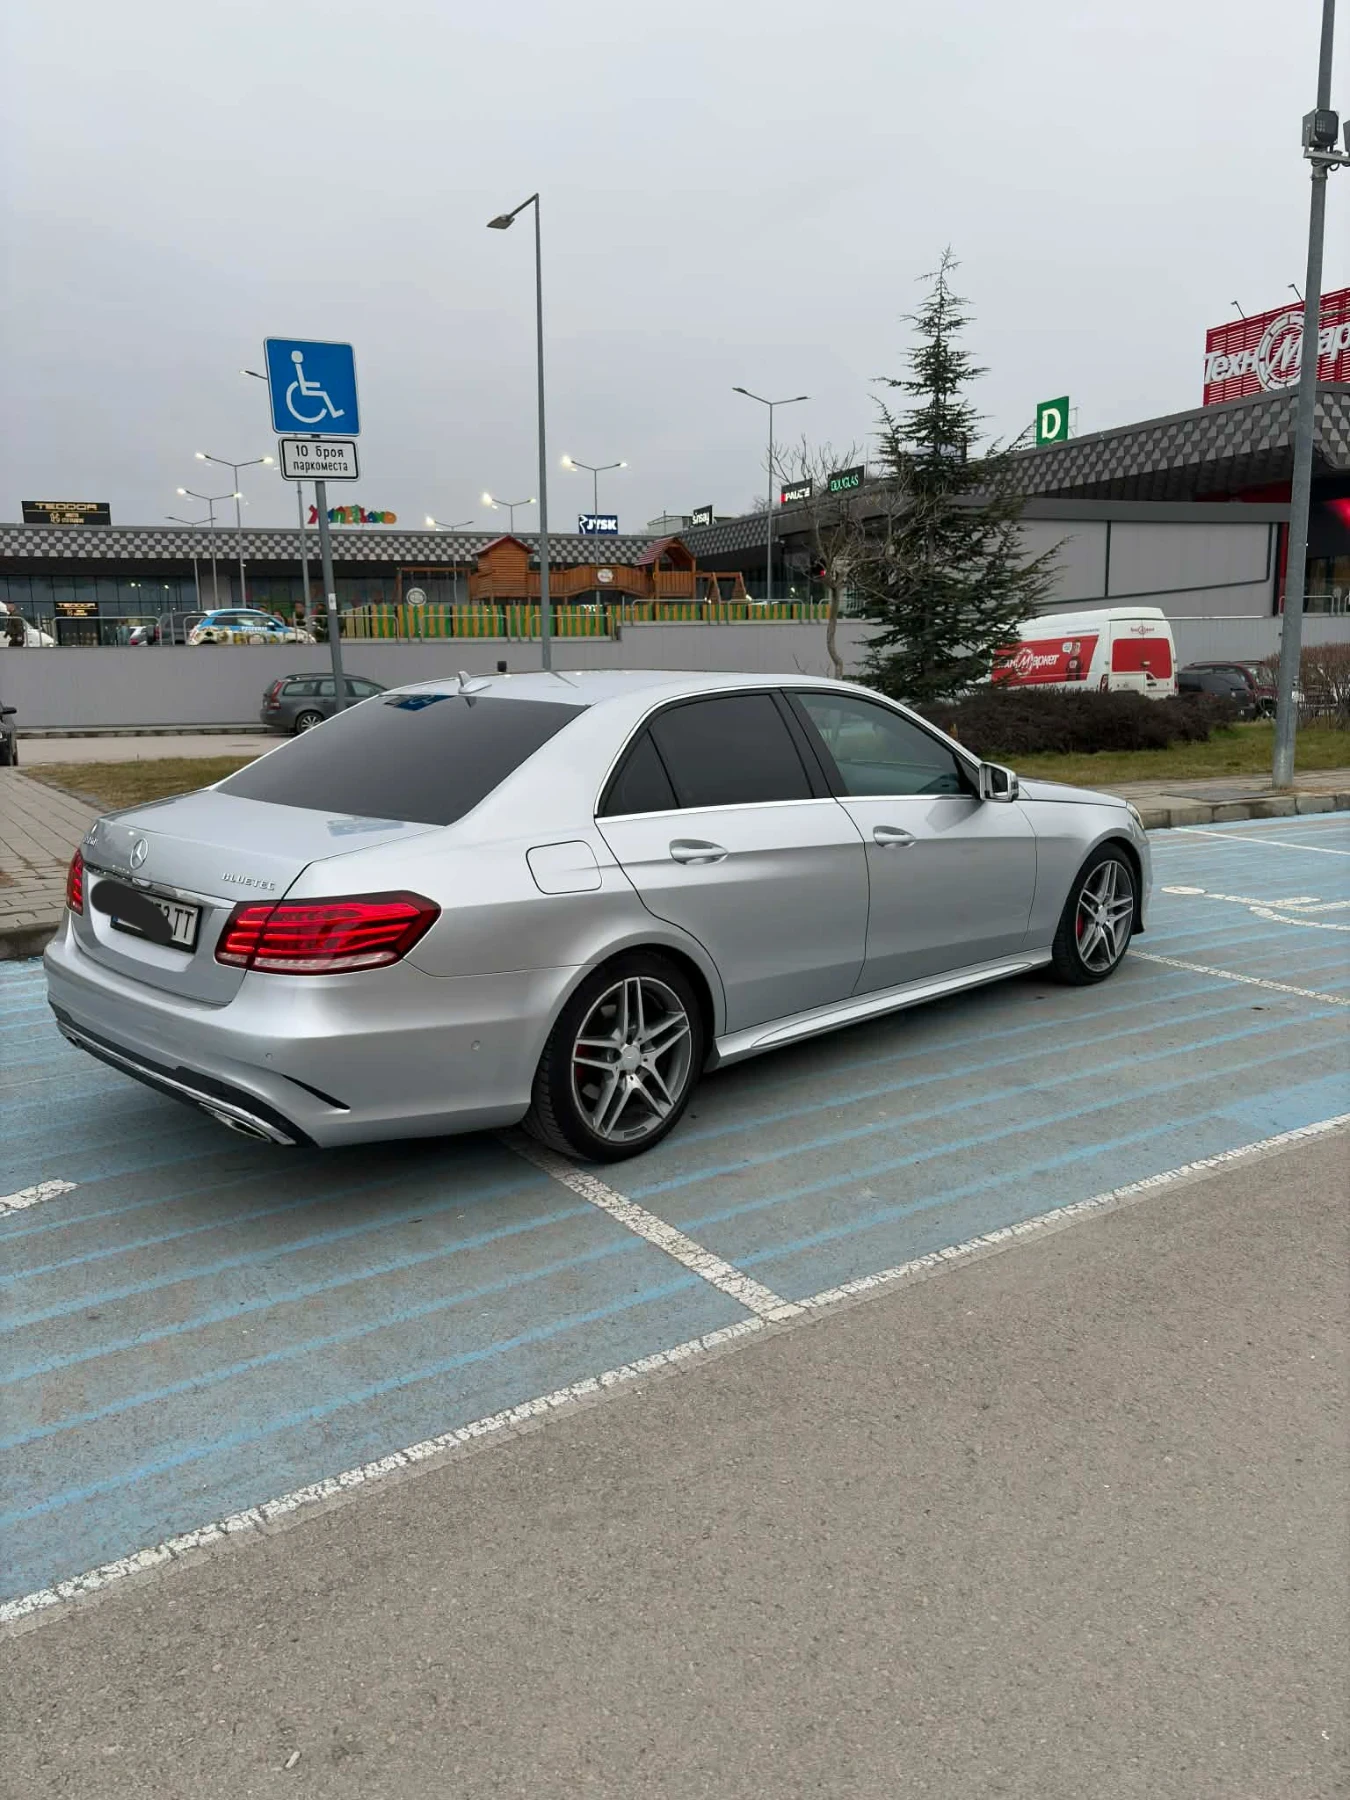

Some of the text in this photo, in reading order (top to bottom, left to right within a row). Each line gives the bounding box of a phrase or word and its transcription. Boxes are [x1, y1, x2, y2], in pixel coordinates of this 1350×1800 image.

[1042, 408, 1061, 439] D
[296, 444, 344, 460] 10 броя
[293, 461, 348, 473] паркоместа
[35, 502, 98, 511] TEODOR
[586, 518, 617, 531] JYSK
[221, 872, 276, 891] BLUETEC
